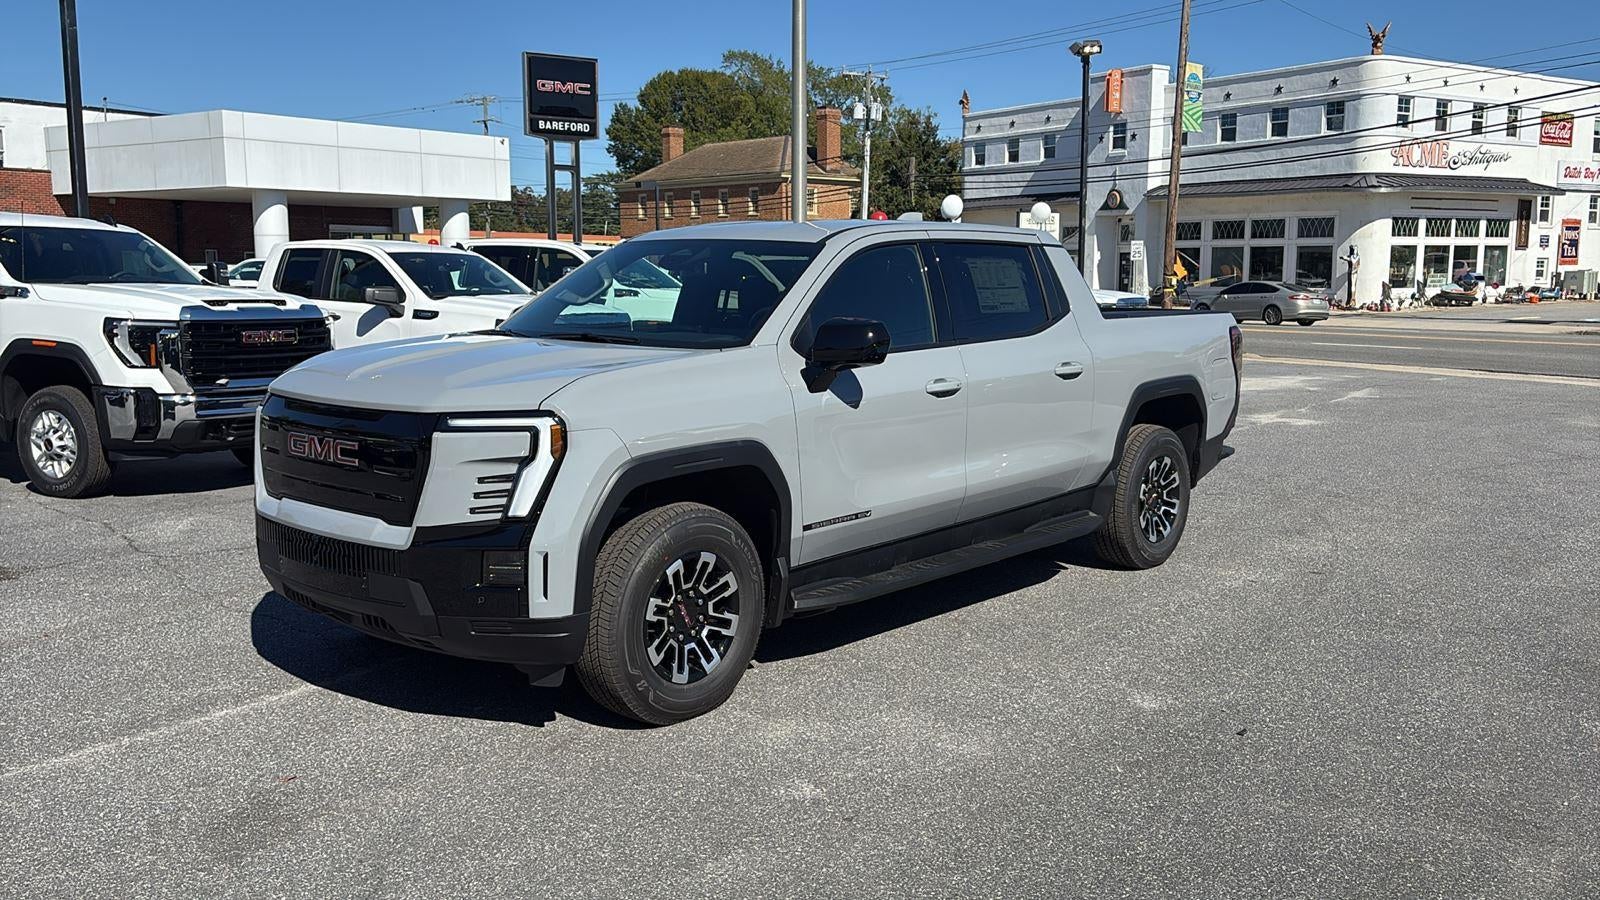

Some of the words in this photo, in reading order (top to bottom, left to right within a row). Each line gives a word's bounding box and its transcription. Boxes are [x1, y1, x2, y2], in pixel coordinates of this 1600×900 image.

[536, 79, 591, 95] GMC
[538, 120, 590, 133] BAREFORD
[1391, 139, 1450, 169] ACME
[1563, 165, 1582, 179] Dutch
[1584, 167, 1597, 182] Boy
[1132, 250, 1142, 258] 25
[1562, 244, 1577, 256] TEA
[243, 329, 295, 343] GMC
[288, 432, 359, 466] GMC
